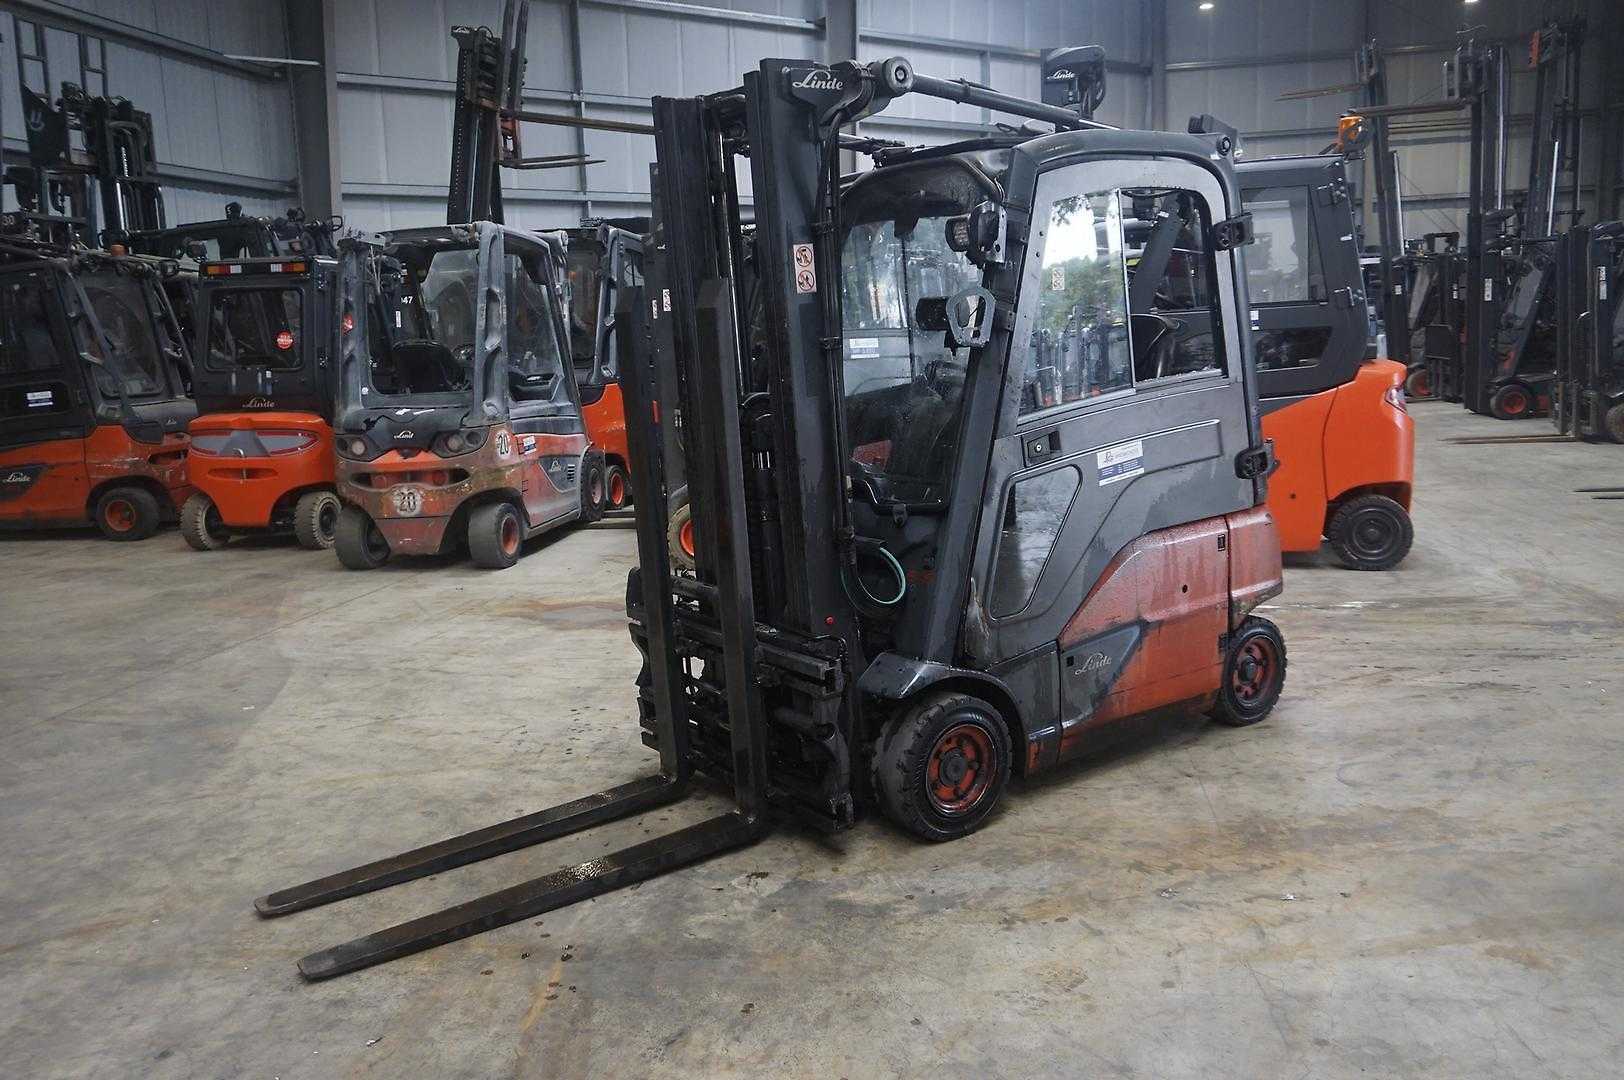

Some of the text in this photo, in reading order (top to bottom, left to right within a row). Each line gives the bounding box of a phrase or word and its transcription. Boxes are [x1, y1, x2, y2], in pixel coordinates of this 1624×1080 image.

[792, 69, 843, 90] Linde
[1046, 69, 1076, 80] Linde
[400, 295, 413, 304] 47
[242, 396, 275, 408] Linde
[498, 434, 509, 455] 20
[2, 471, 31, 482] Linde
[400, 491, 417, 512] 20
[1075, 652, 1112, 675] Linde
